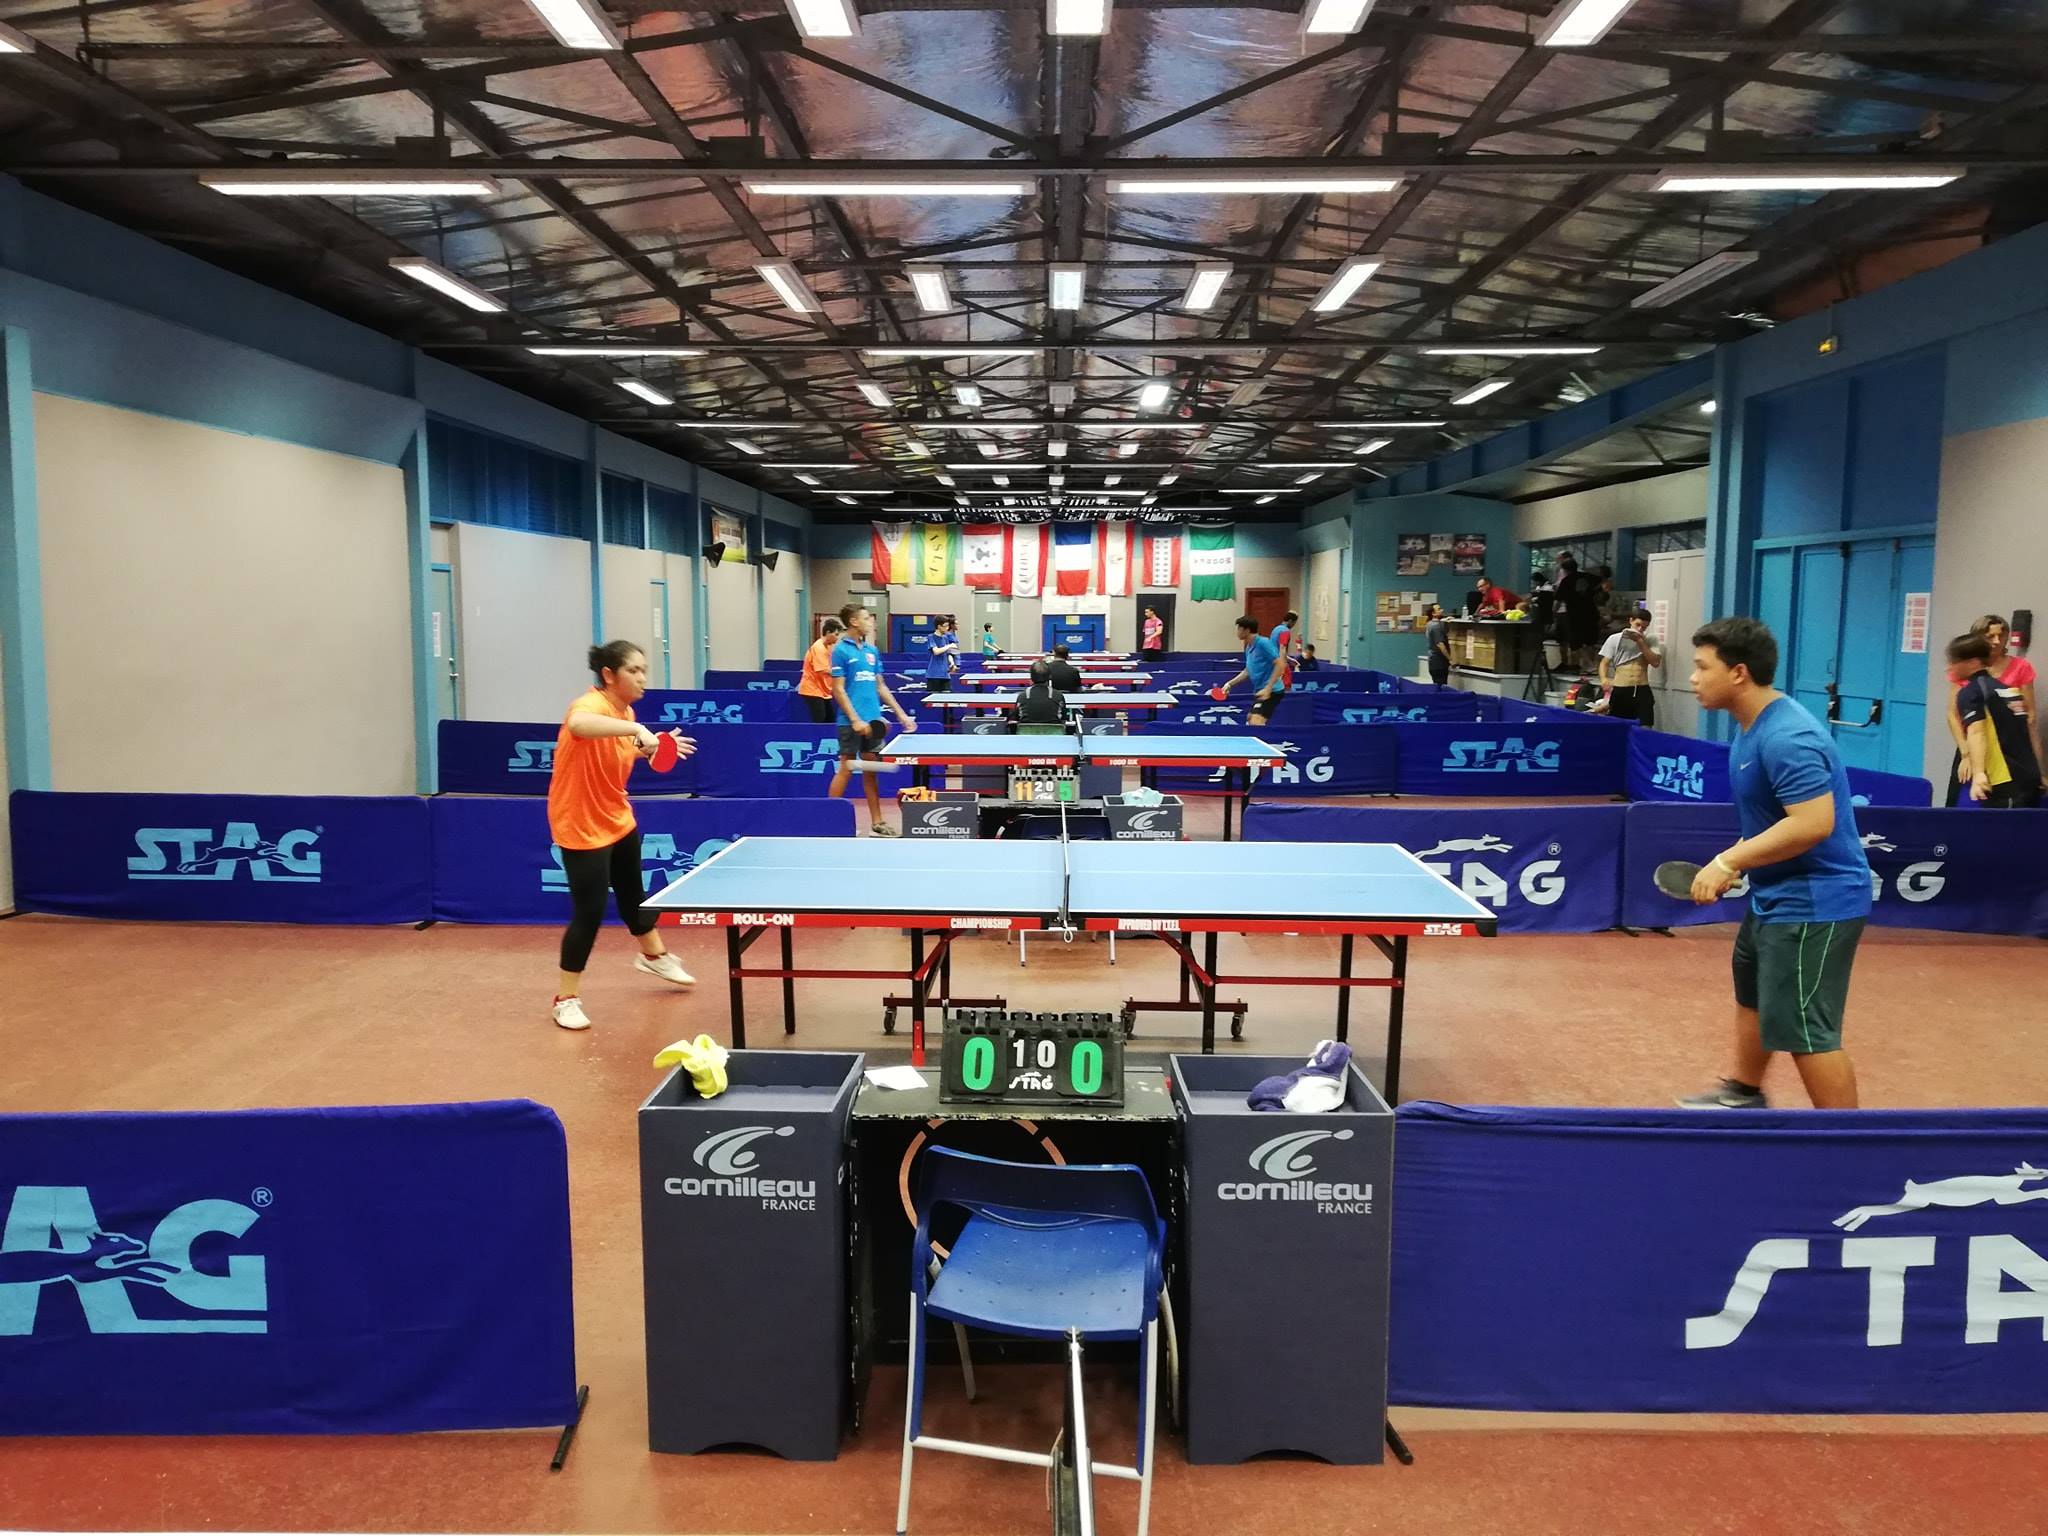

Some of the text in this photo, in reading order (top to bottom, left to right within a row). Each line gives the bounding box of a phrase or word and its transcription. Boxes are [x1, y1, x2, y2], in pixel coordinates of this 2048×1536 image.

[508, 741, 559, 772] ST
[760, 739, 842, 773] STA
[1442, 737, 1560, 773] STAG
[1015, 781, 1033, 801] 11
[1060, 781, 1073, 801] 5
[127, 822, 322, 882] STAG
[680, 912, 717, 925] STAG
[732, 913, 795, 926] ROLL-ON
[950, 917, 1012, 929] CHAMPIONSHIP
[1423, 922, 1463, 936] STAG
[962, 1036, 996, 1091] 0
[1071, 1040, 1104, 1095] 0
[1008, 1076, 1055, 1090] STAG
[664, 1176, 817, 1198] cornilleau
[1217, 1180, 1374, 1201] cornilleau
[762, 1199, 817, 1212] FRANCE
[1317, 1202, 1374, 1215] FRANCE
[0, 1185, 269, 1336] AG
[1685, 1234, 2048, 1350] STA
